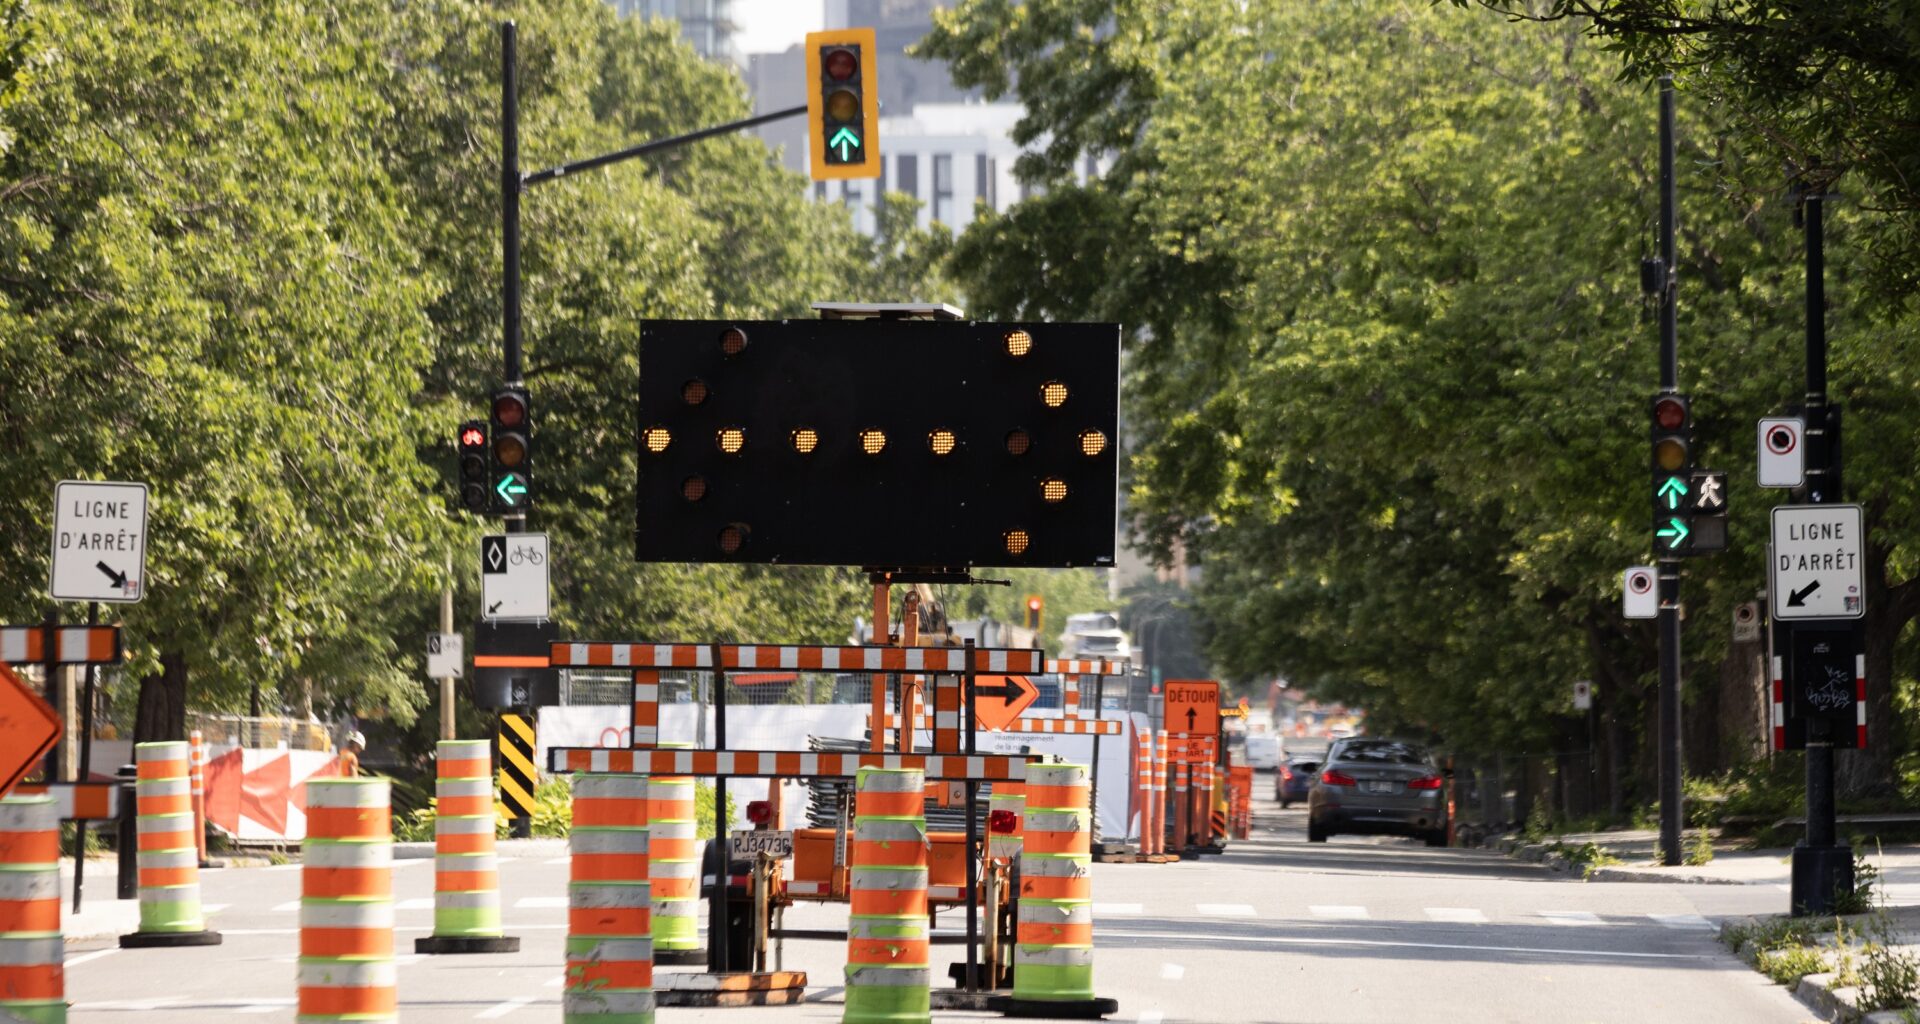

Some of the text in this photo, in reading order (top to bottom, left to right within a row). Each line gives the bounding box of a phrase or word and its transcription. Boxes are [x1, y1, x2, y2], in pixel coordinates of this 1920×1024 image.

[74, 500, 129, 519] LIGNE
[60, 528, 137, 552] D'ARRÊT
[1790, 523, 1844, 541] LIGNE
[1780, 548, 1856, 571] D'ARRÊT
[1168, 687, 1216, 703] DÉTOUR
